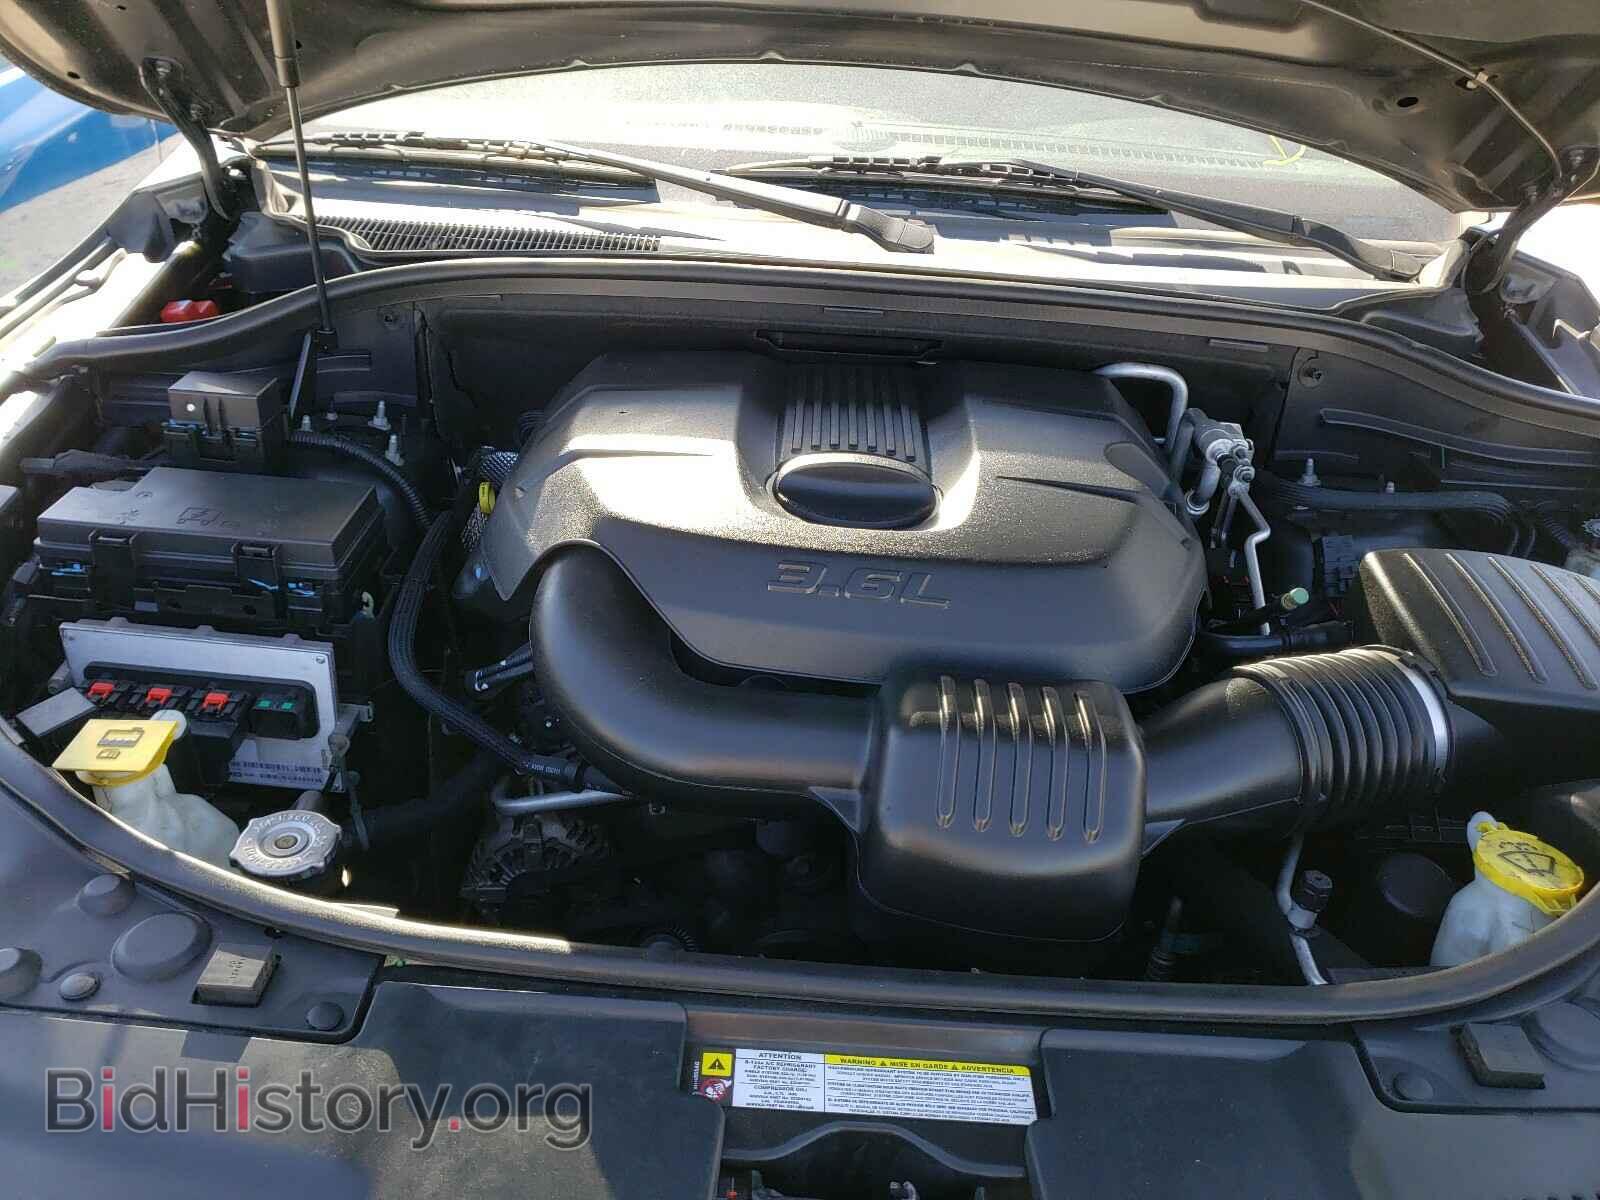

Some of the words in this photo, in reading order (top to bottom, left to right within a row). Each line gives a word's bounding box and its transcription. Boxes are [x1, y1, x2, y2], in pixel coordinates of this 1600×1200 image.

[768, 560, 950, 609] 3.6L
[758, 1052, 802, 1060] ATTENTION
[839, 1057, 877, 1066] WARNING
[889, 1059, 909, 1067] MISE
[922, 1062, 949, 1070] GARDE
[961, 1064, 1014, 1074] ADVERTENCIA
